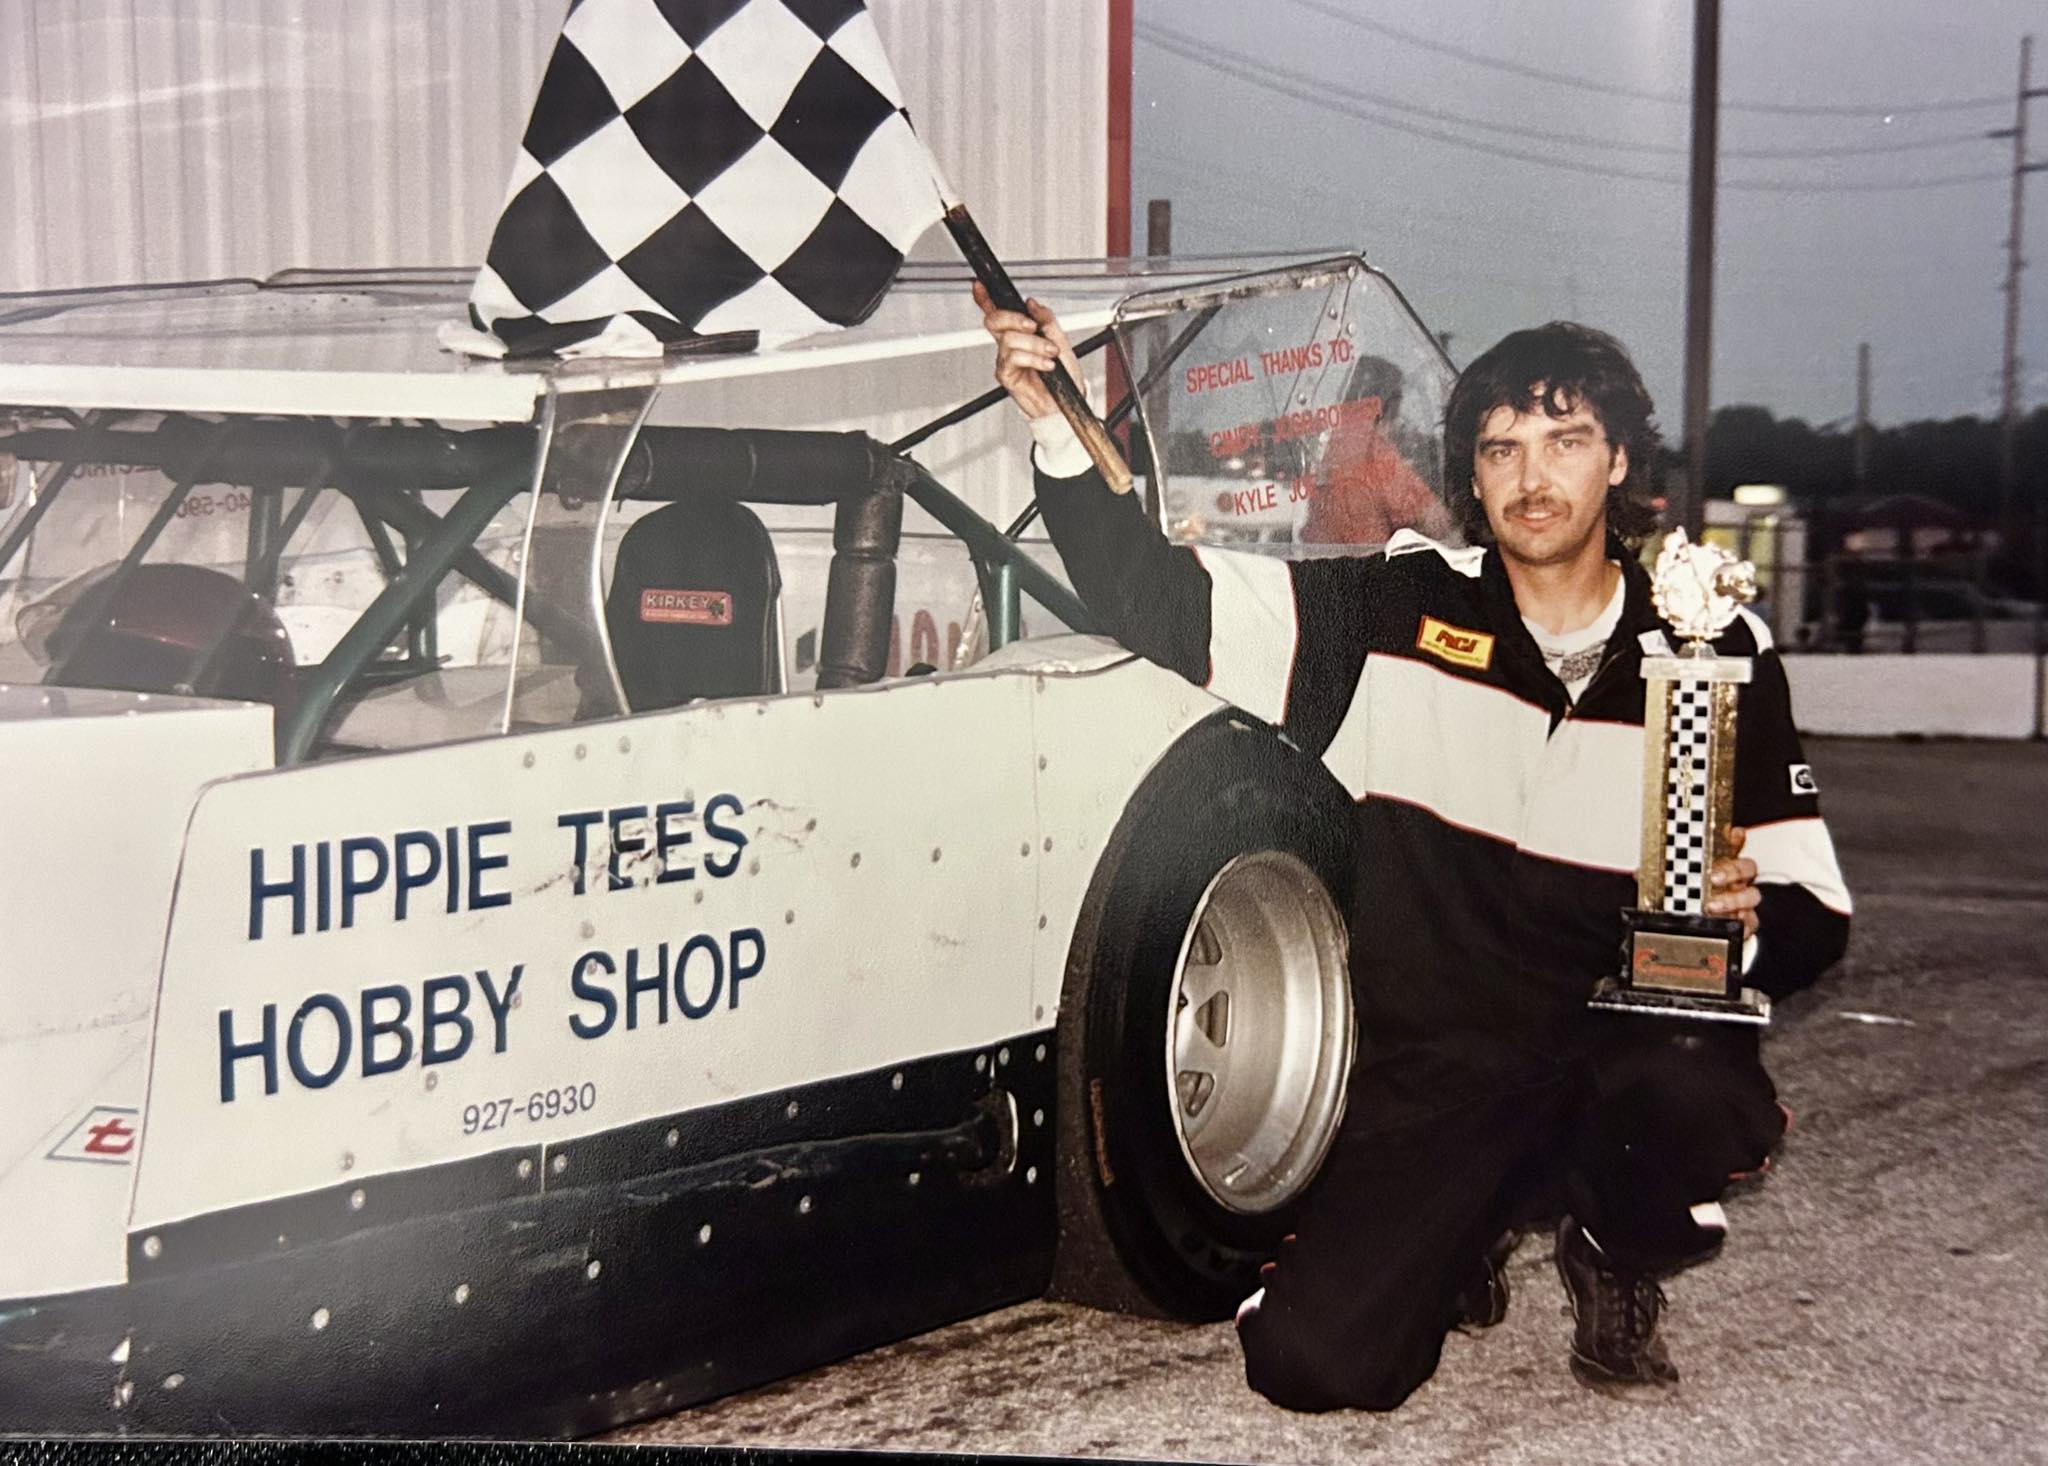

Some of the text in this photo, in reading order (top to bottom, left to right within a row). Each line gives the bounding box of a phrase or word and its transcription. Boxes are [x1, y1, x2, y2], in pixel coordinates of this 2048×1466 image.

[1187, 359, 1254, 393] SPECIAL
[1260, 343, 1322, 376] THANKS
[1234, 484, 1277, 516] KYLE
[646, 594, 711, 609] KIRKEY
[249, 794, 748, 941] HIPPIE TEES
[219, 927, 767, 1103] HOBBY SHOP
[463, 1082, 597, 1135] 927-6930
